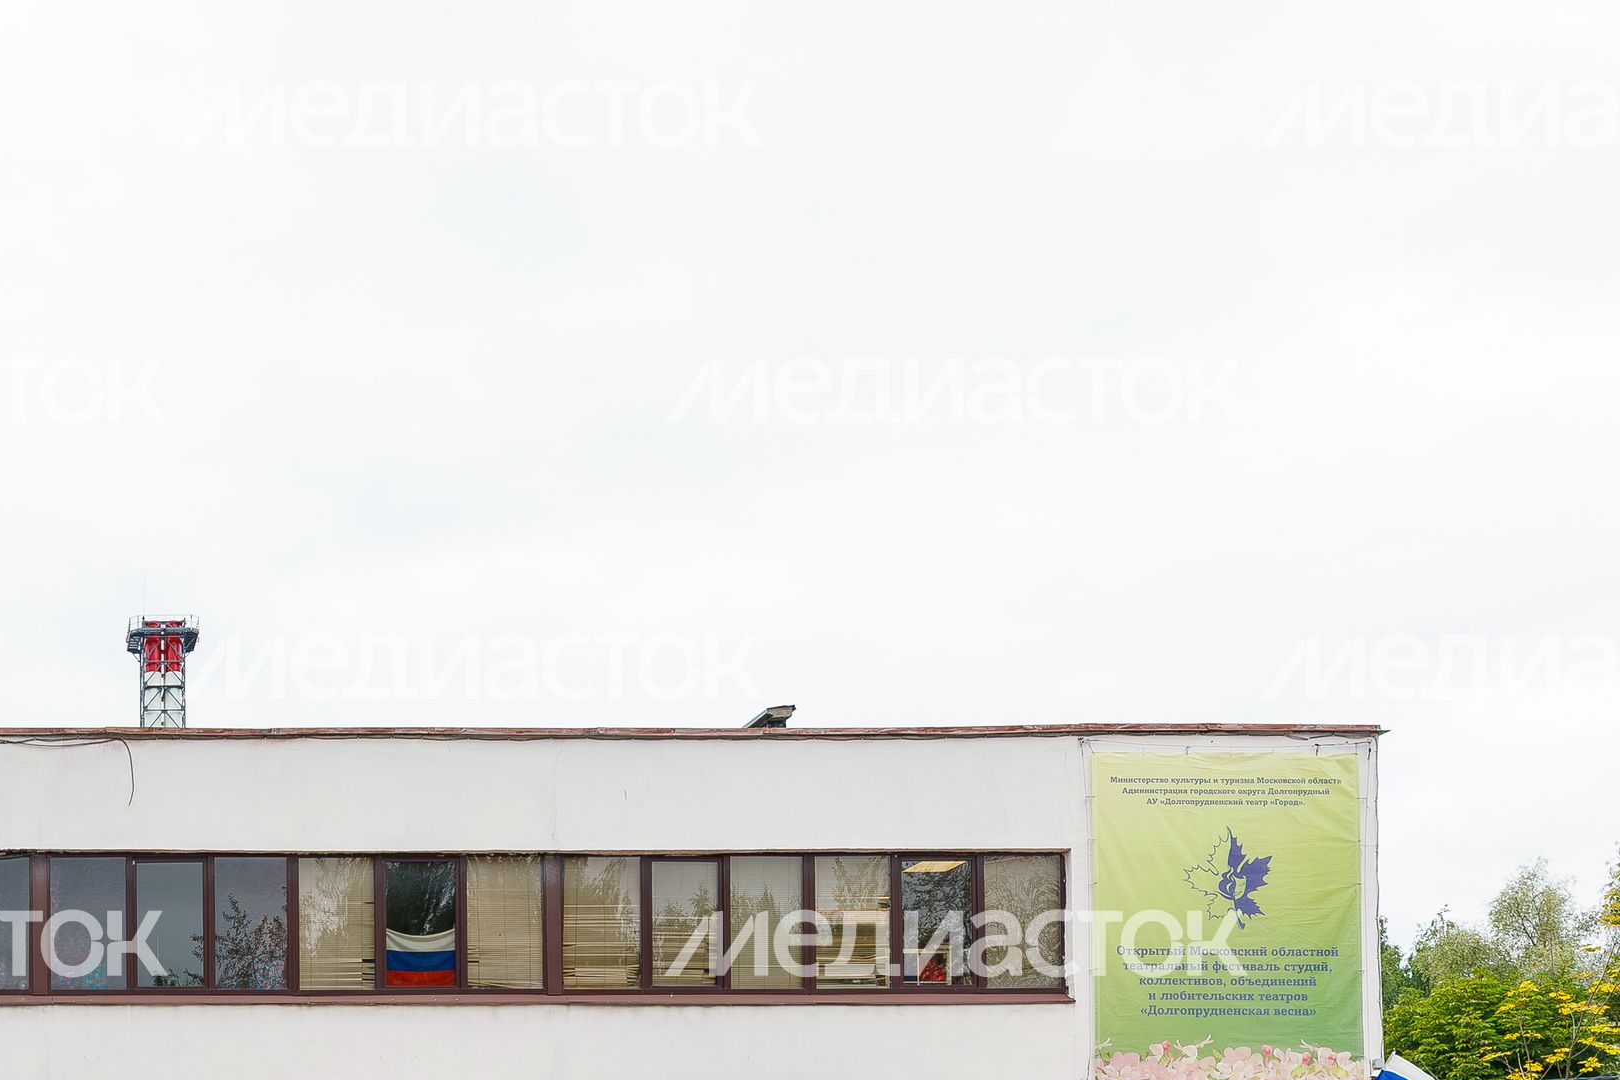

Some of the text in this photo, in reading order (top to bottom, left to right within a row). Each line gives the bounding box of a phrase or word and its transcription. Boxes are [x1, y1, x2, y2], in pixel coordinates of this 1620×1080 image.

[1110, 776, 1169, 785] Министерство
[1171, 777, 1211, 786] культуры
[1220, 777, 1255, 786] туризма
[1256, 776, 1306, 784] Московской
[1307, 776, 1342, 785] области
[1122, 787, 1330, 796] Администрация городского округа Долгопрудный
[1160, 798, 1243, 807] «Долгопрудненский
[1245, 799, 1268, 807] театр
[1116, 945, 1339, 958] Открытый Московский областной
[1123, 961, 1333, 974] театральный фестиваль студий,
[1139, 976, 1317, 988] коллективов, объединений
[1148, 991, 1308, 1004] и любительских театров
[1140, 1005, 1317, 1018] «Долгопрудненская весна»
